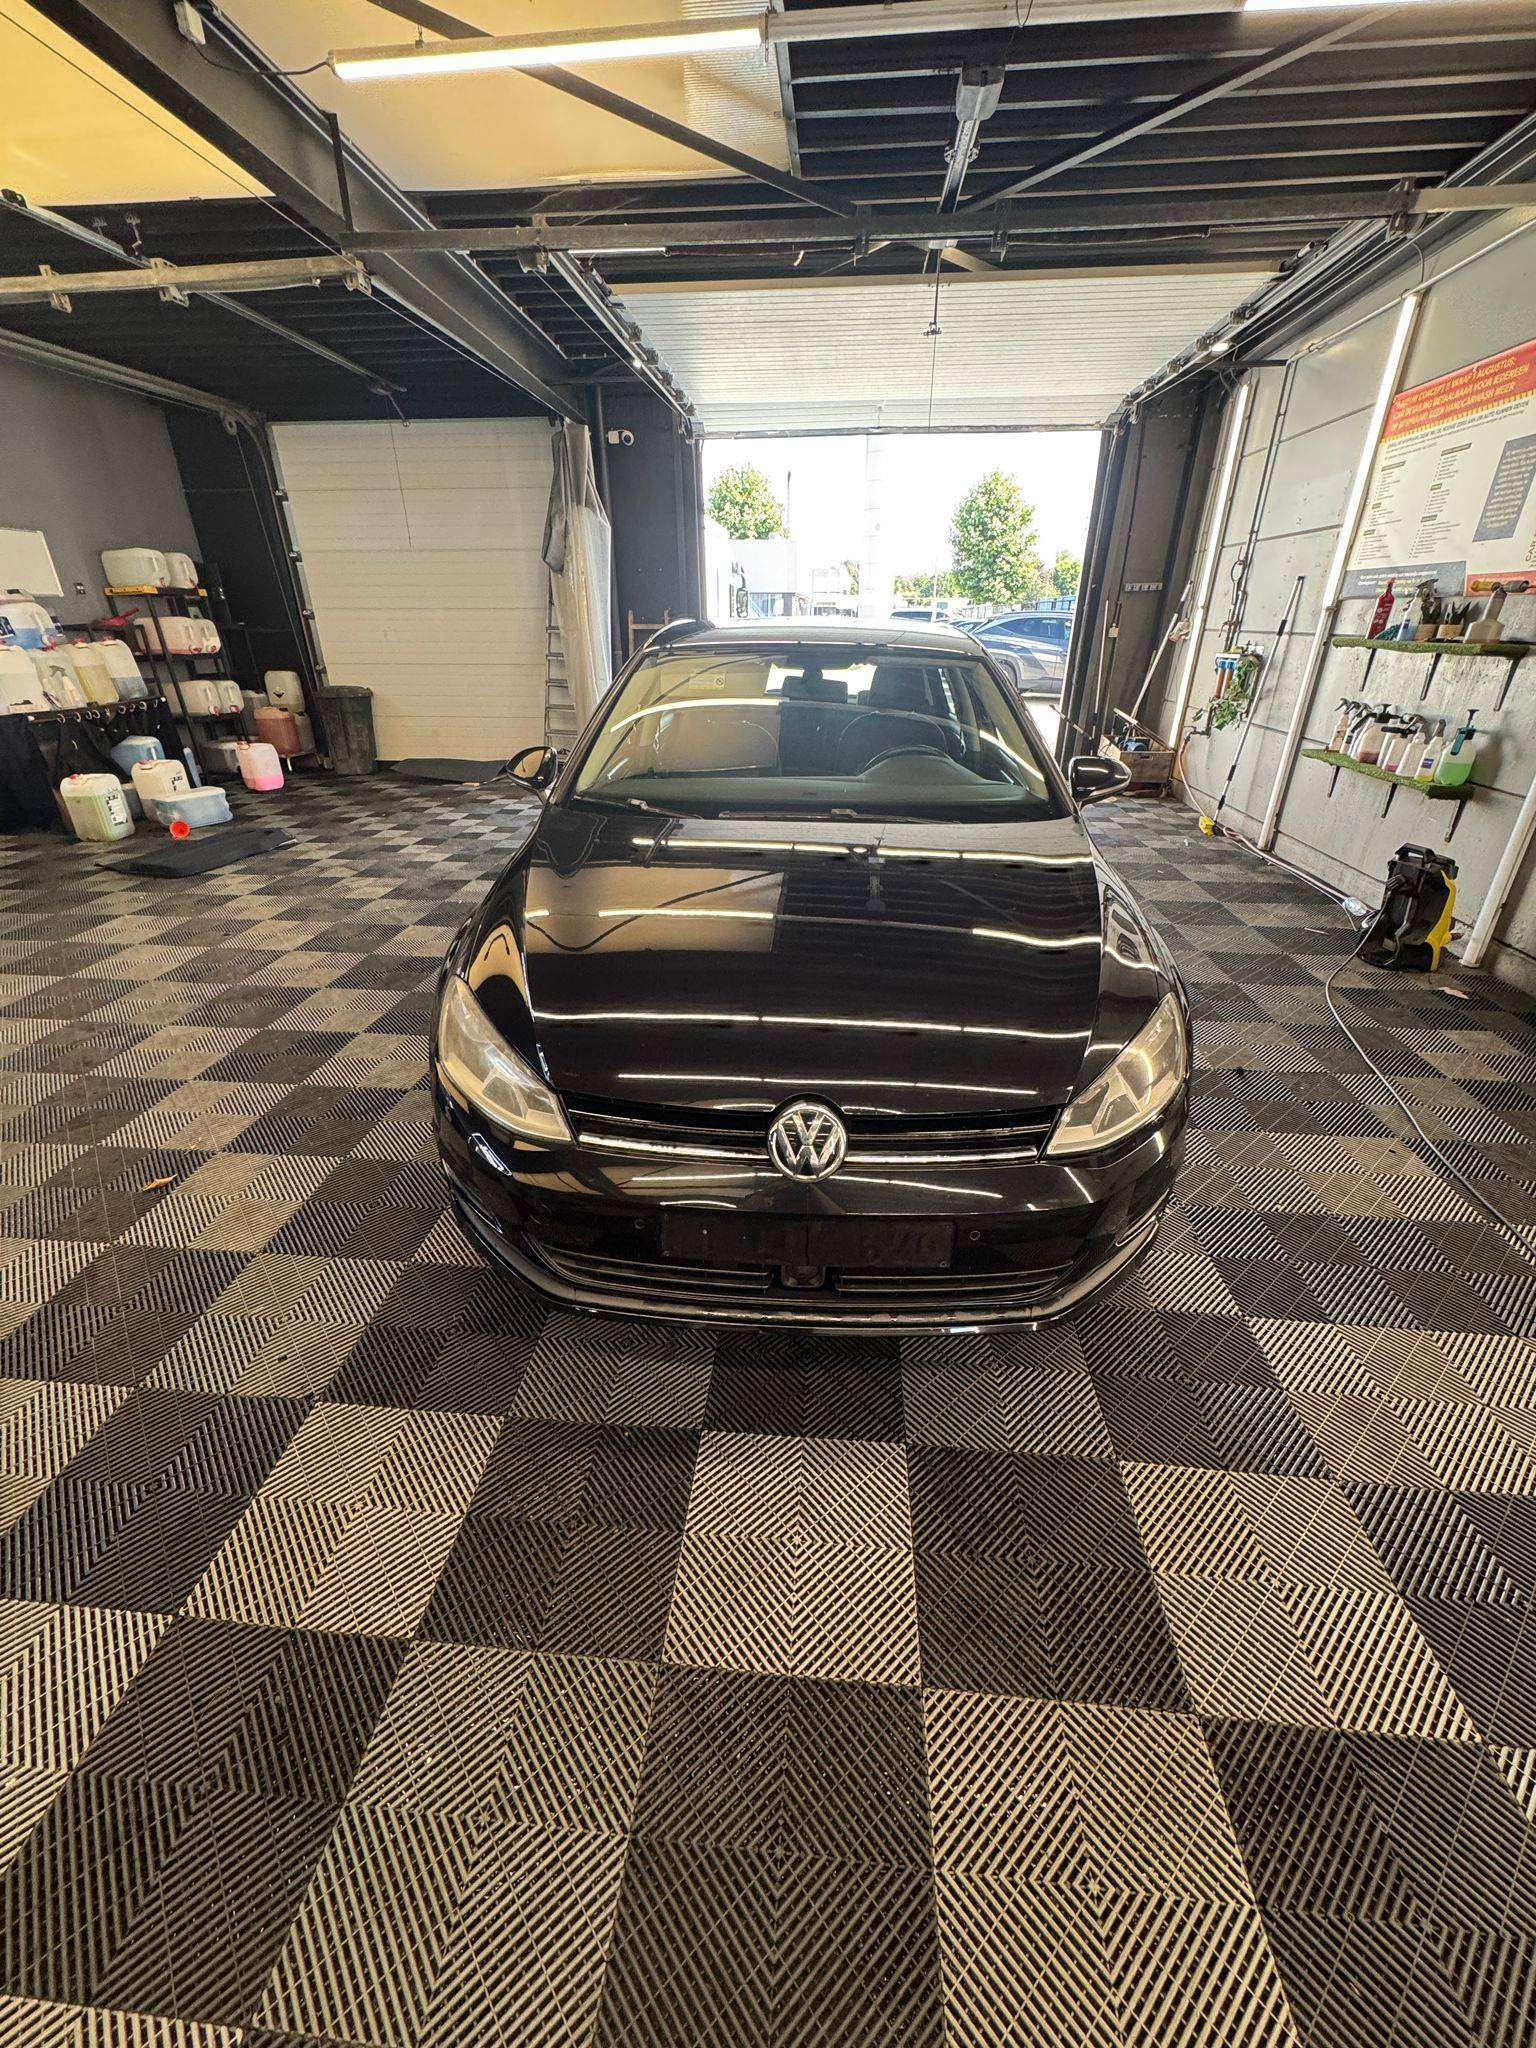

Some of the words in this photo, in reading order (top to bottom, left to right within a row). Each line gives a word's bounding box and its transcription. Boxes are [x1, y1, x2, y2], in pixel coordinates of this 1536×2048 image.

[1433, 384, 1473, 405] BETAALBAAR
[1473, 377, 1494, 392] VOOR
[1493, 364, 1530, 383] IEDEREEN
[1494, 381, 1516, 394] MEER
[774, 1104, 842, 1178] VW
